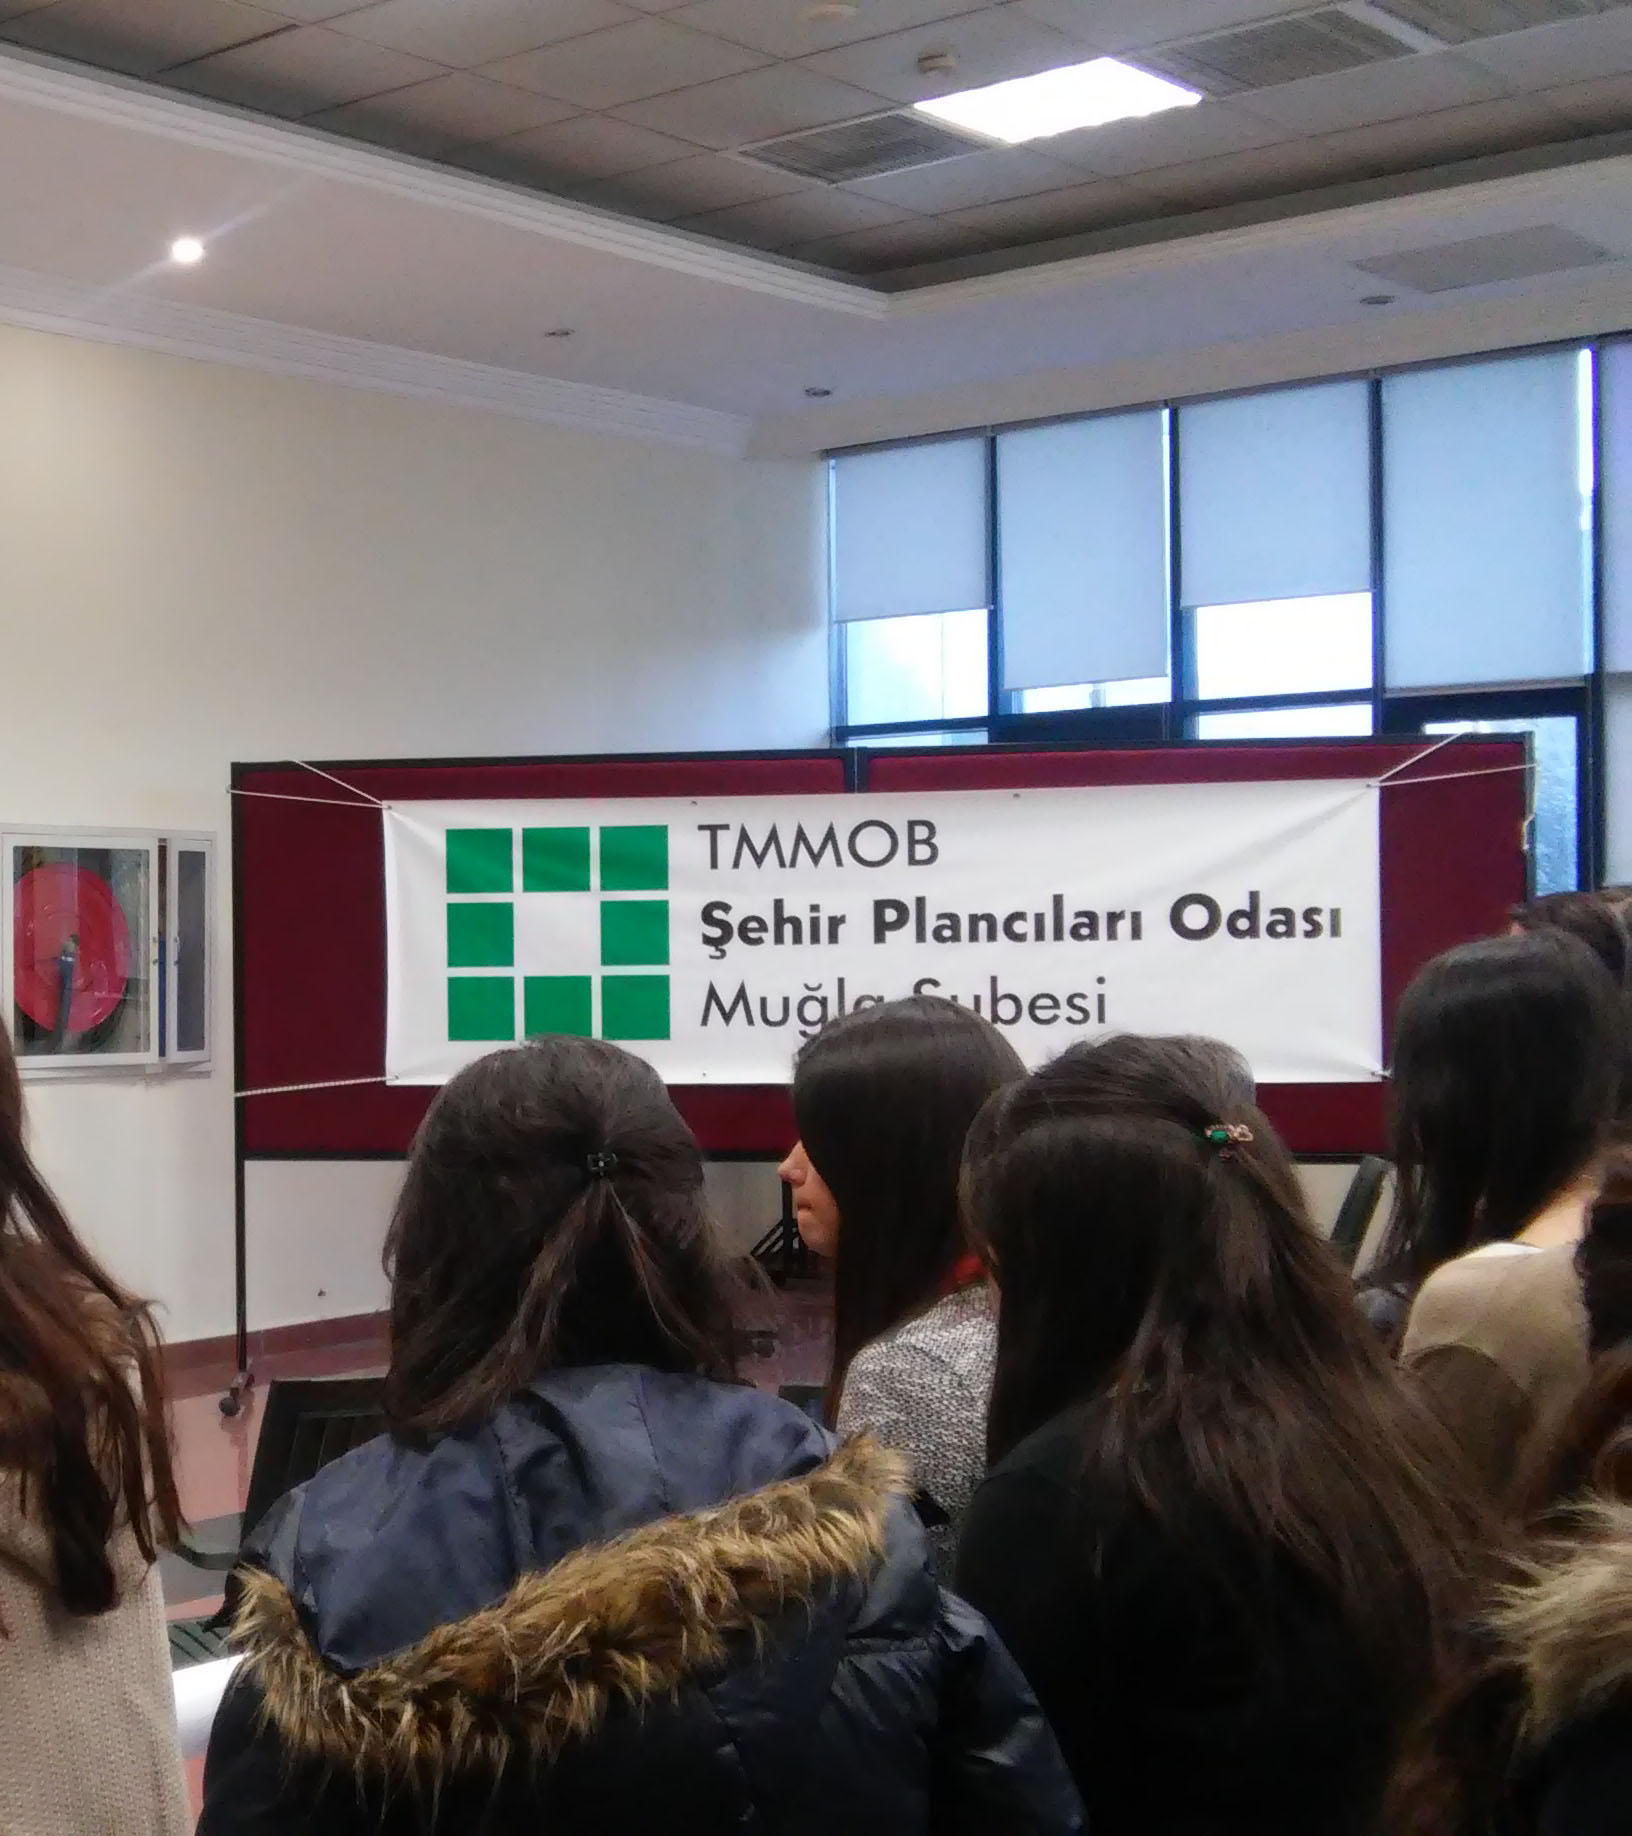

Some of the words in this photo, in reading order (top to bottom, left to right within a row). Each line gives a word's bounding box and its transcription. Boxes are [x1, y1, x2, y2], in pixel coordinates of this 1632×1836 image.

[697, 819, 939, 870] TMMOB
[700, 898, 846, 960] Şehir
[872, 893, 1143, 945] Plancıları
[1168, 890, 1341, 942] Odası
